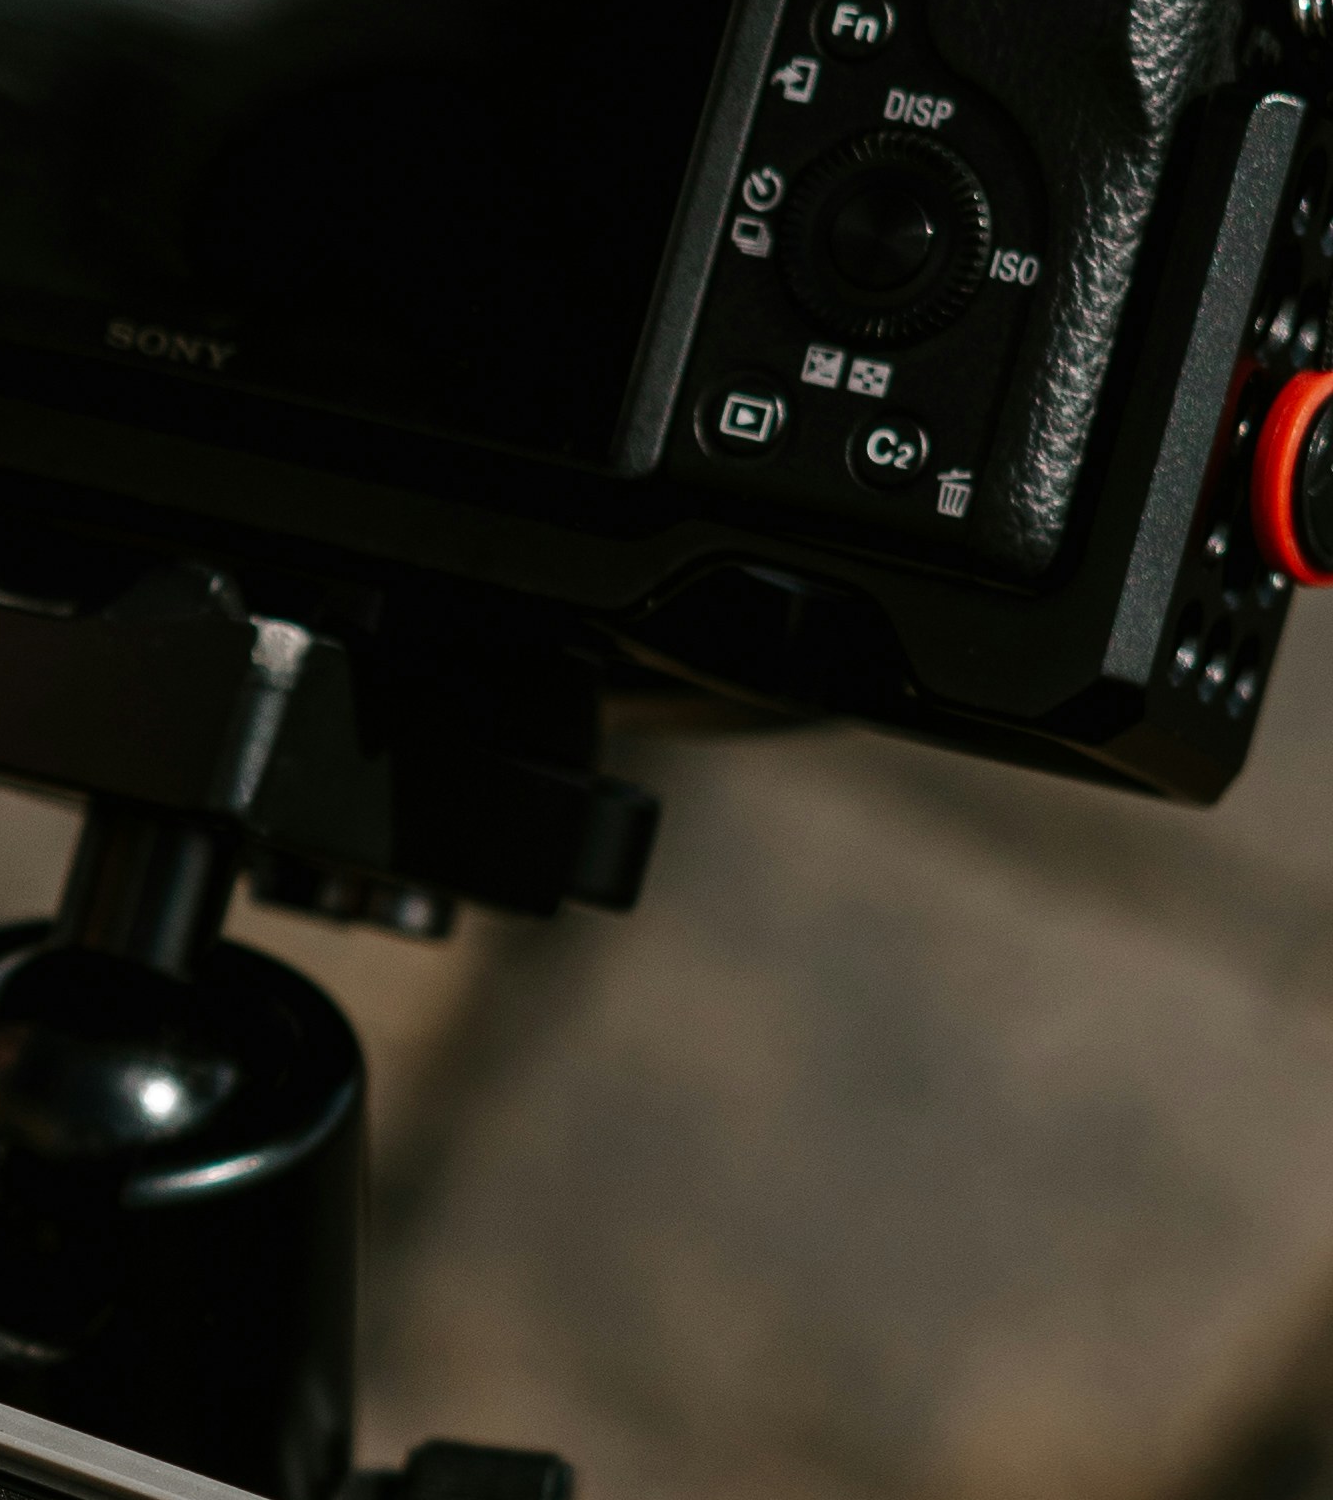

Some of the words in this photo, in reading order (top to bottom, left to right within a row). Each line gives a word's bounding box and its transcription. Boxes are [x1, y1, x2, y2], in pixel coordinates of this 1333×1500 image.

[831, 4, 880, 44] Fn
[884, 89, 954, 131] DISP
[989, 249, 1040, 286] ISO
[104, 318, 236, 370] SONY
[865, 429, 917, 470] C2
